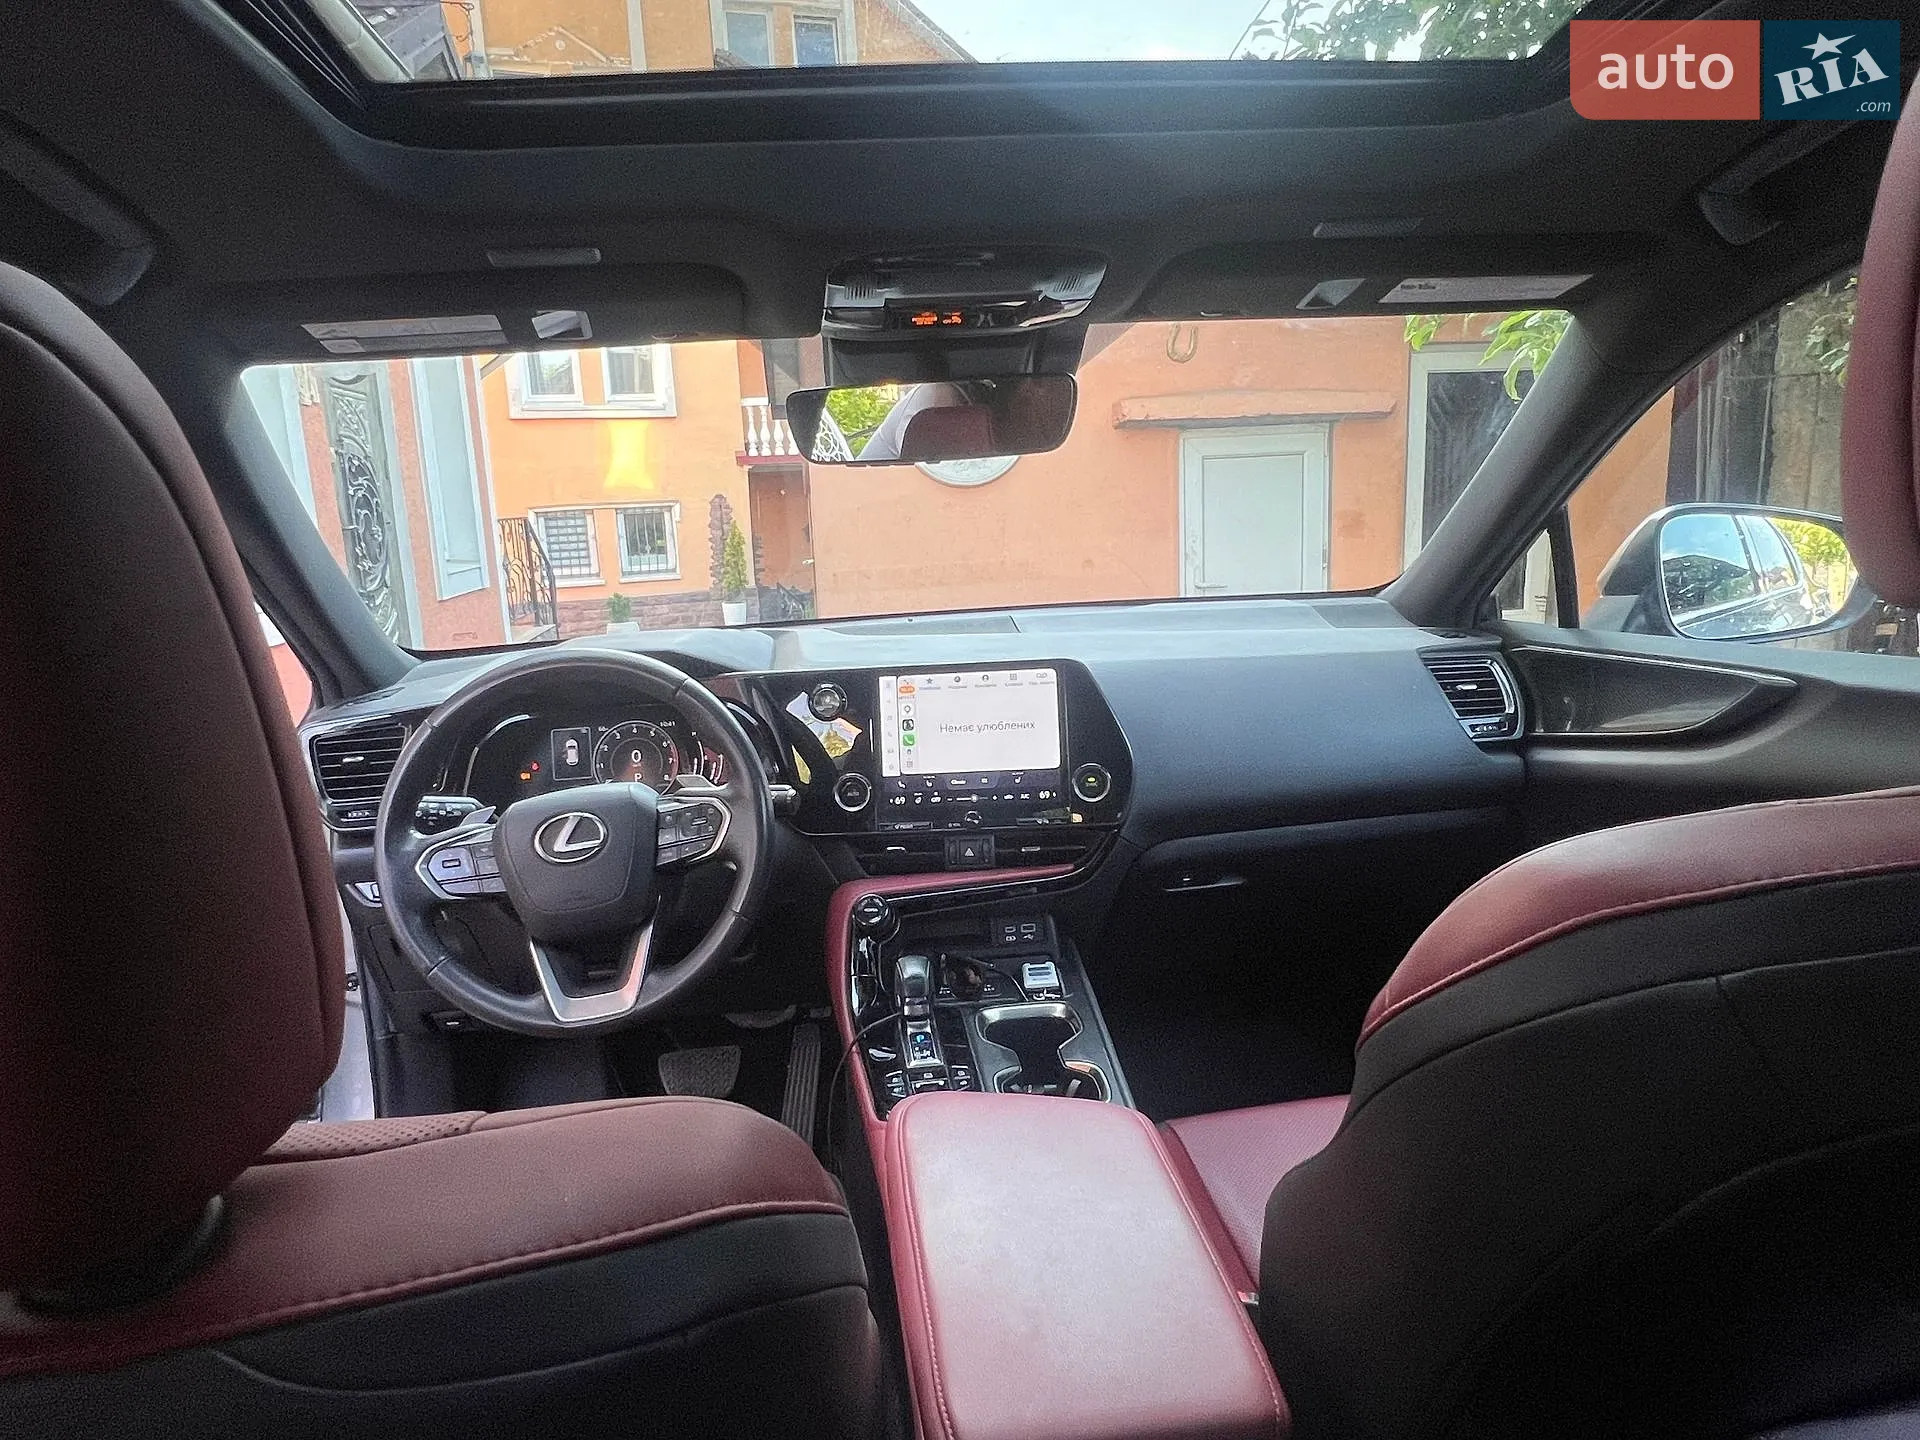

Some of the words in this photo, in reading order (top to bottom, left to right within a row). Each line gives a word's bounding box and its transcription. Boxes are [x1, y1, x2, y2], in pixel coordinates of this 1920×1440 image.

[939, 722, 976, 734] Немає
[977, 719, 1036, 734] улюблених
[631, 749, 642, 763] 0
[634, 773, 643, 782] P
[1039, 790, 1051, 800] 69
[895, 796, 906, 805] 69
